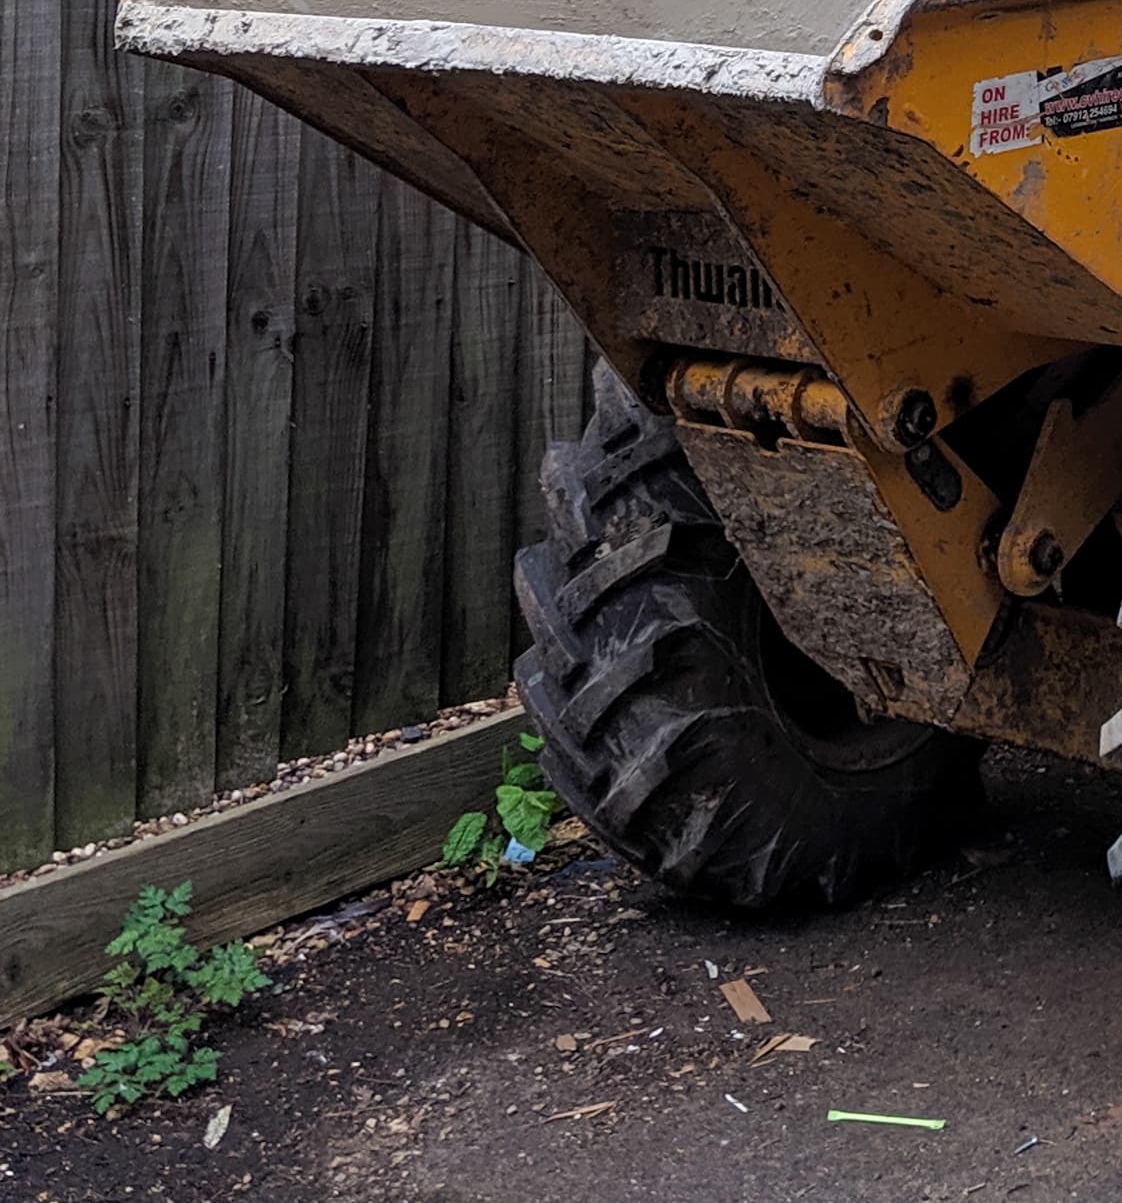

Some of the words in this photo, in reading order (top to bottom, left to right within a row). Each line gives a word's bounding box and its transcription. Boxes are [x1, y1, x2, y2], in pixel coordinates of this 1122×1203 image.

[982, 85, 1005, 103] ON
[980, 104, 1019, 125] HIRE
[979, 124, 1029, 148] FROM:
